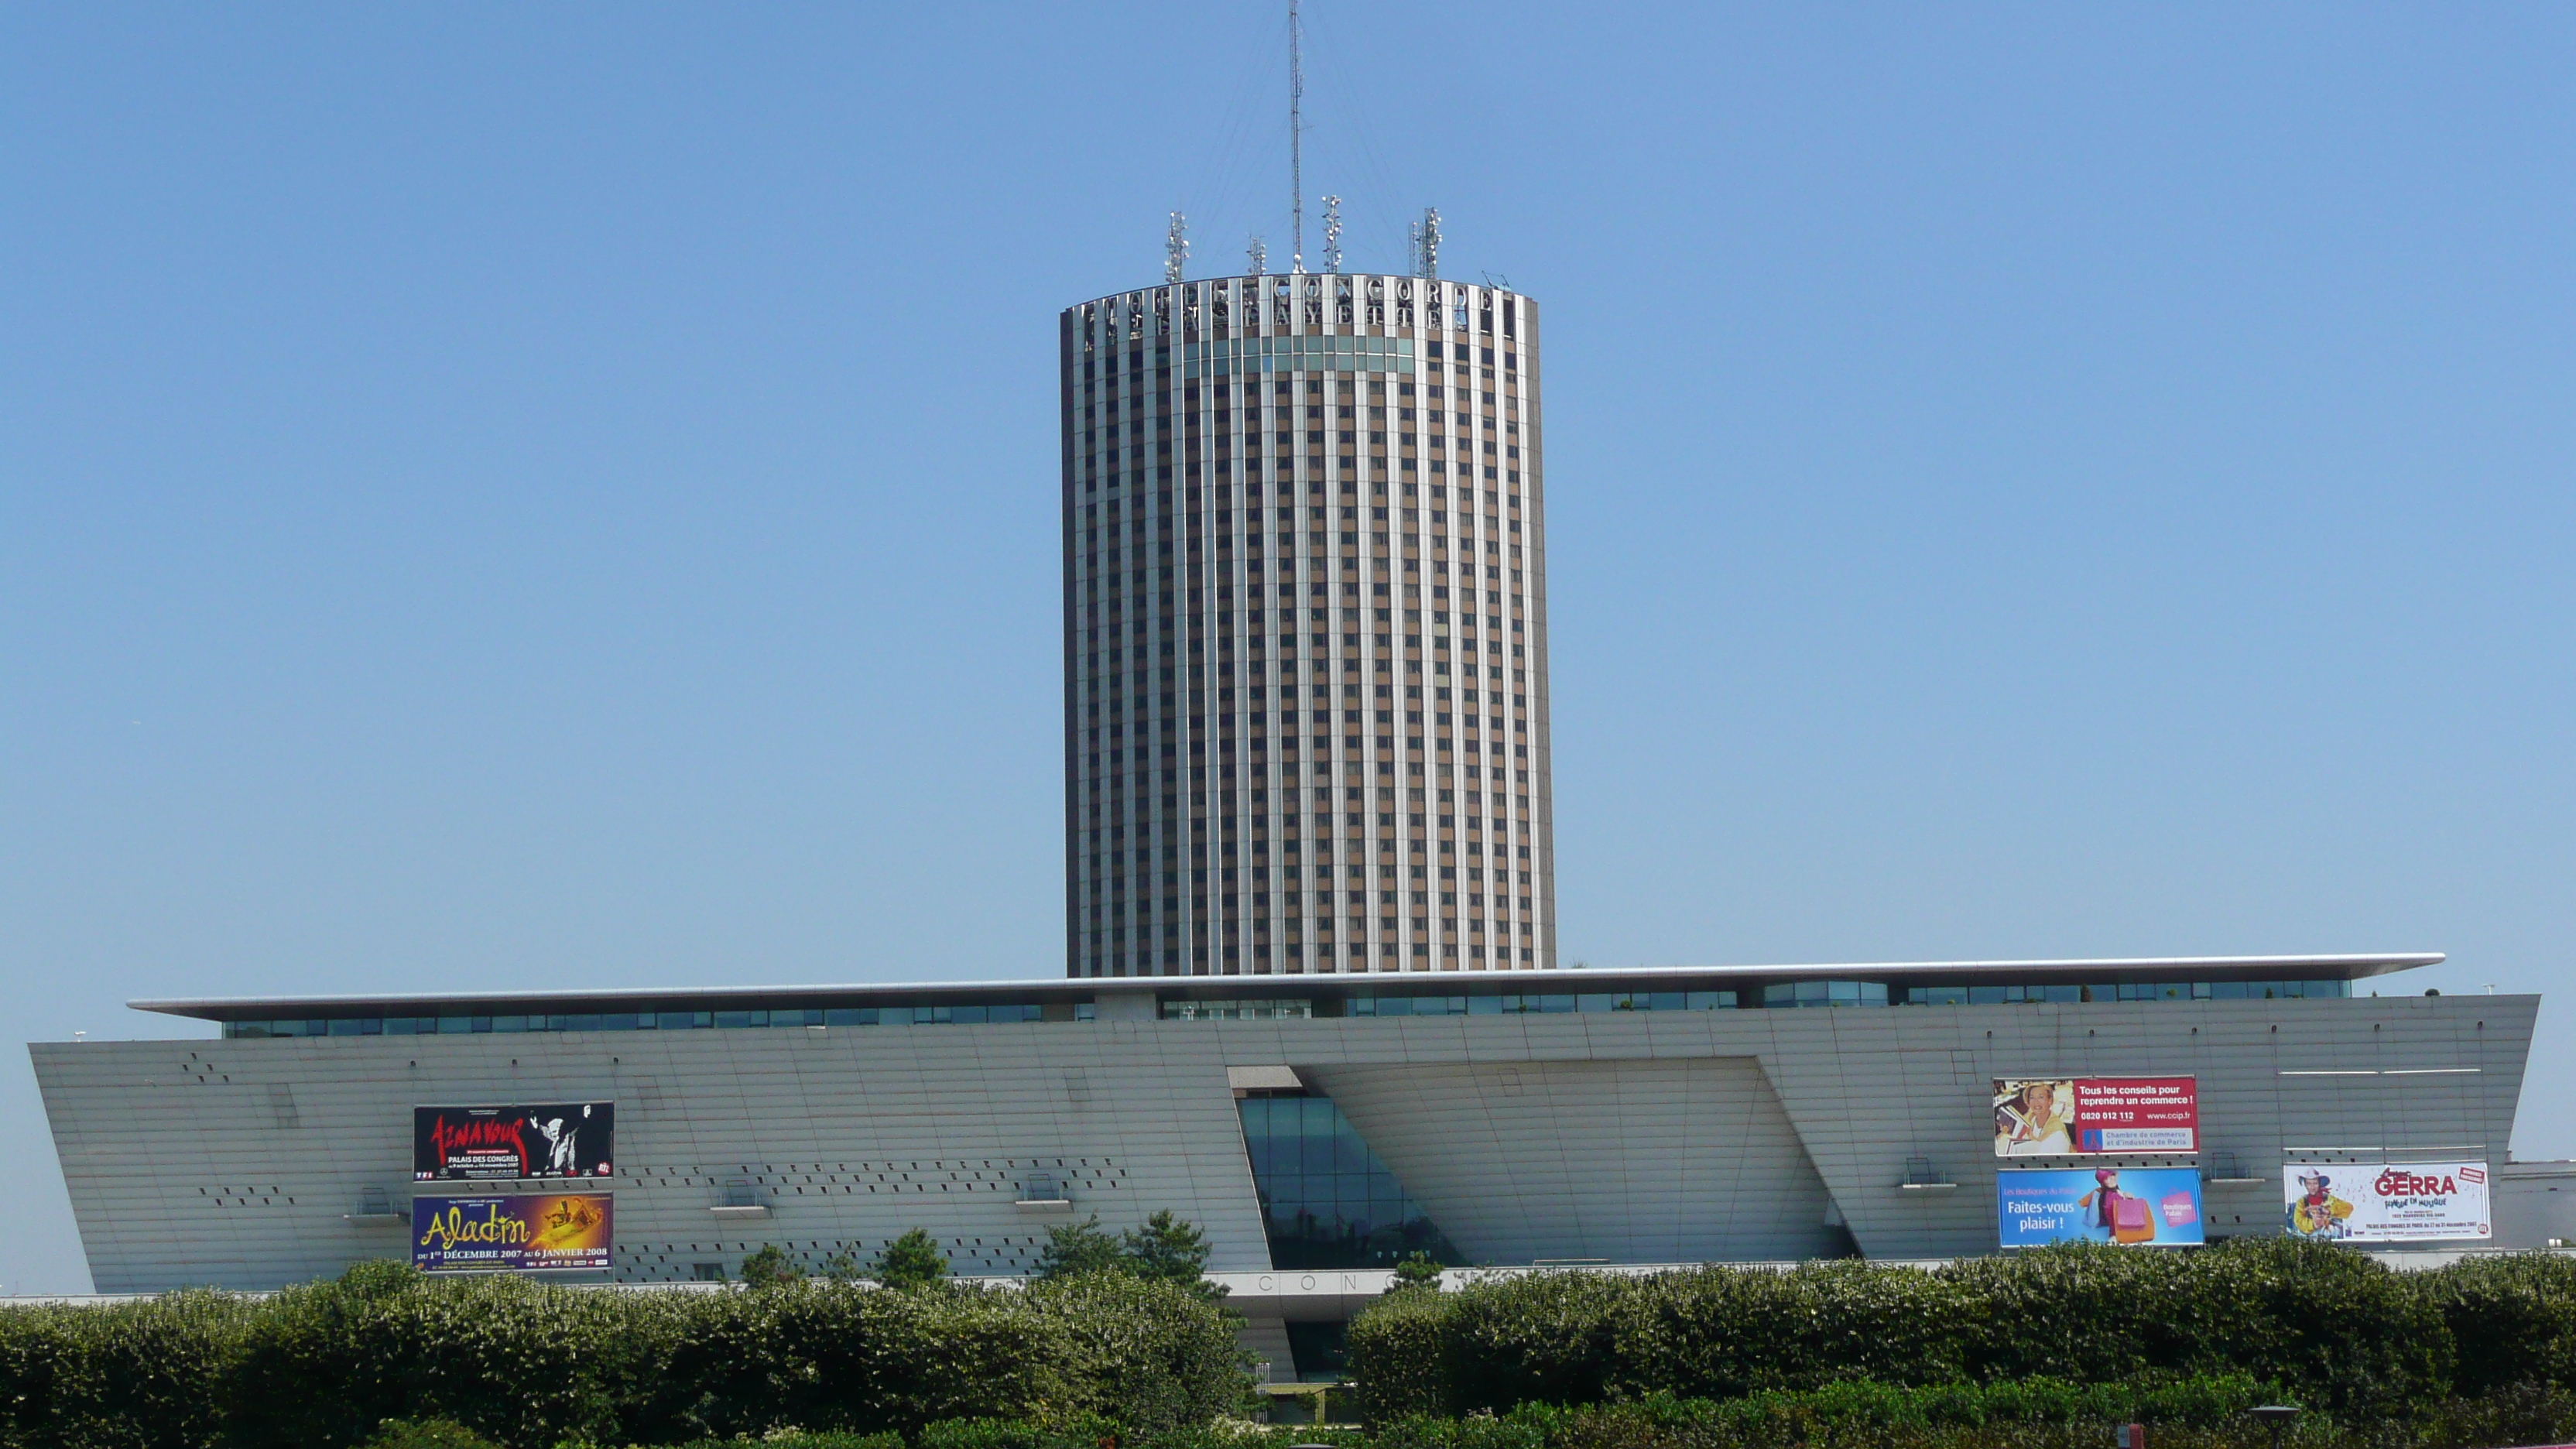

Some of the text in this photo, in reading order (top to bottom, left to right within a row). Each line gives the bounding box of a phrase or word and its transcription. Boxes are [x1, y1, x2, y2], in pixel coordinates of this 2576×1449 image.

[1273, 278, 1492, 310] CONCORDE
[1242, 303, 1444, 330] FAYETTE
[2080, 1086, 2180, 1095] Tous les conseils pour
[2081, 1096, 2124, 1107] reprendre
[2146, 1112, 2191, 1121] www.ccip.fr
[487, 1154, 519, 1163] CONGRÈS
[2375, 1175, 2458, 1197] GERRA
[2008, 1201, 2074, 1213] Faites-vous
[420, 1204, 531, 1249] Aladin
[2019, 1216, 2064, 1232] plaisir !
[444, 1249, 498, 1259] DÉCEMBRE
[501, 1250, 522, 1259] 2007
[542, 1249, 583, 1259] JANVIER
